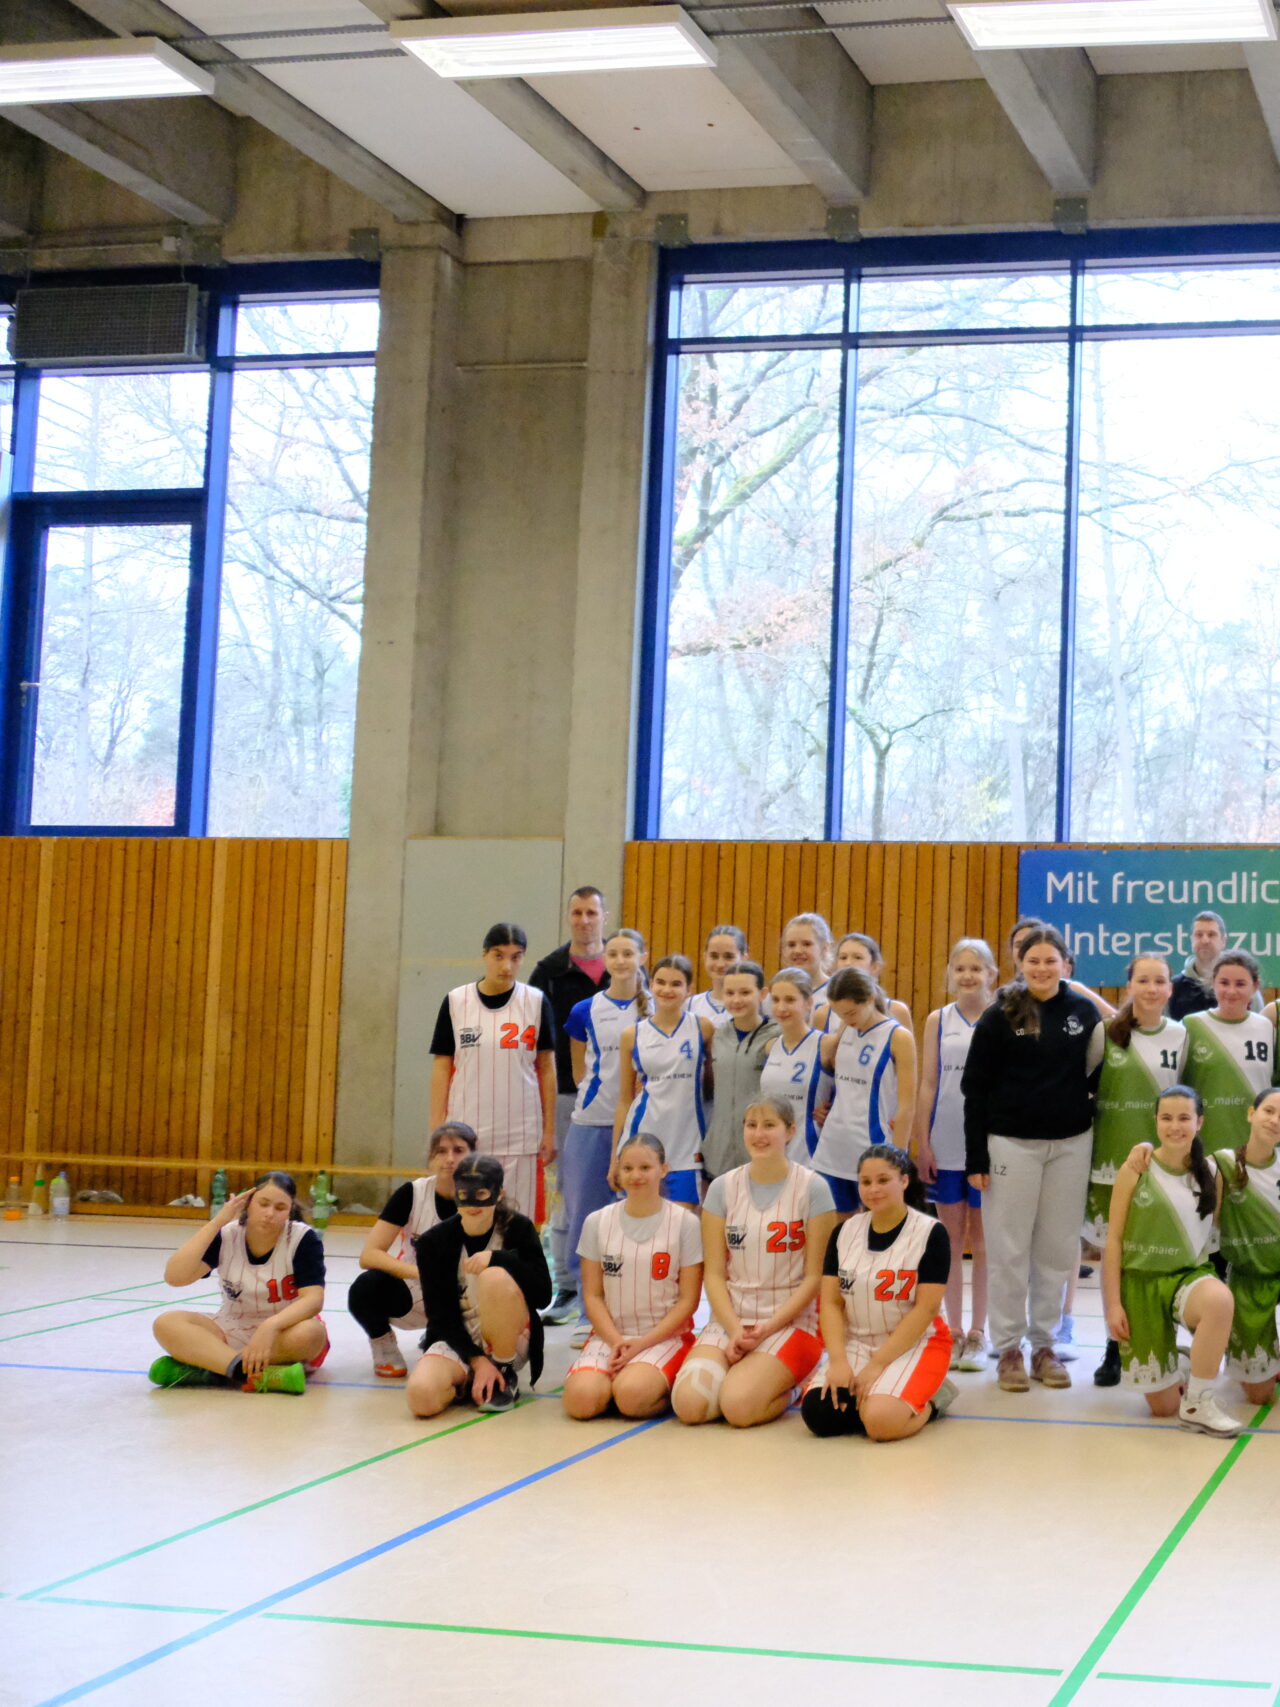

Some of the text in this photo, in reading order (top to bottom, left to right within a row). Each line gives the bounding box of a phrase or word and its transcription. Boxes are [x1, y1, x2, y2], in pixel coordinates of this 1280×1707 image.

[1046, 871, 1099, 904] Mit
[500, 1022, 537, 1051] 24
[679, 1039, 693, 1060] 4
[1244, 1040, 1269, 1062] 18
[857, 1043, 875, 1067] 6
[1160, 1049, 1178, 1071] 11
[789, 1061, 807, 1083] 2
[766, 1219, 806, 1253] 25
[651, 1252, 671, 1281] 8
[266, 1274, 300, 1304] 16
[874, 1268, 918, 1302] 27
